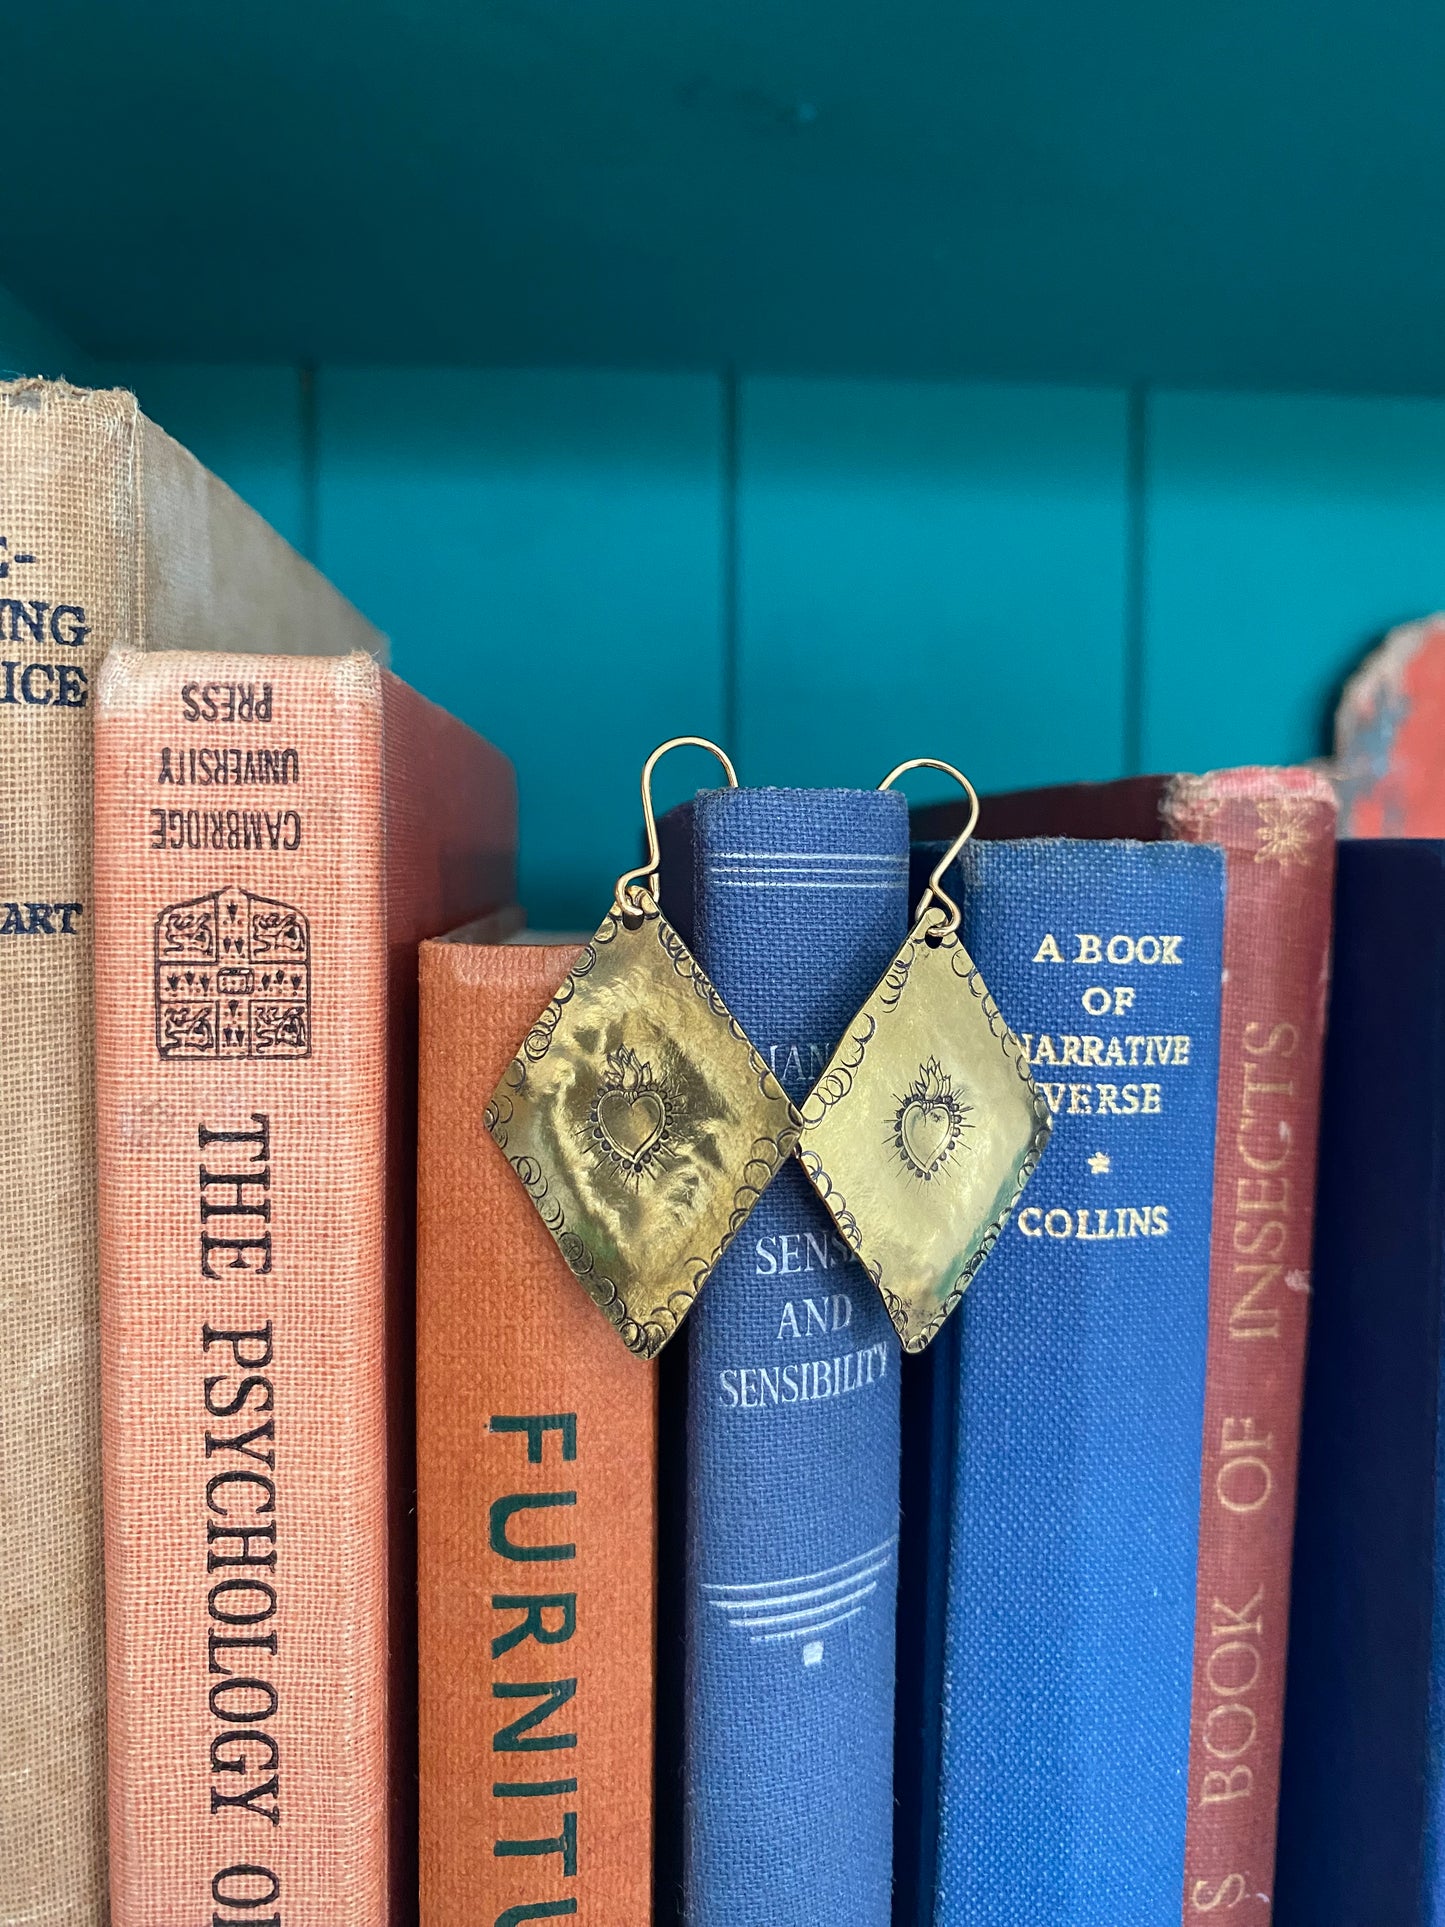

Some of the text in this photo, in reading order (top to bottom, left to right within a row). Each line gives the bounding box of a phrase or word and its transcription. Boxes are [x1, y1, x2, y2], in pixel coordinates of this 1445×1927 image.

[0, 660, 88, 707] ICE
[181, 681, 273, 722] PRESS
[158, 747, 299, 786] UNIVERSITY
[151, 808, 301, 851] CAMBRIDGE
[0, 902, 83, 935] ART
[1032, 934, 1183, 965] A BOOK
[1081, 986, 1137, 1016] OF
[1035, 1082, 1161, 1115] VERSE
[199, 1113, 272, 1280] THE
[1228, 1021, 1299, 1341] INSECTS
[1018, 1206, 1169, 1240] COLLINS
[755, 1229, 856, 1275] SENS
[776, 1293, 853, 1340] AND
[718, 1340, 888, 1408] SENSIBILITY
[1216, 1416, 1274, 1512] OF
[203, 1319, 280, 1827] PSYCHOLOGY
[1201, 1583, 1265, 1810] BOOK
